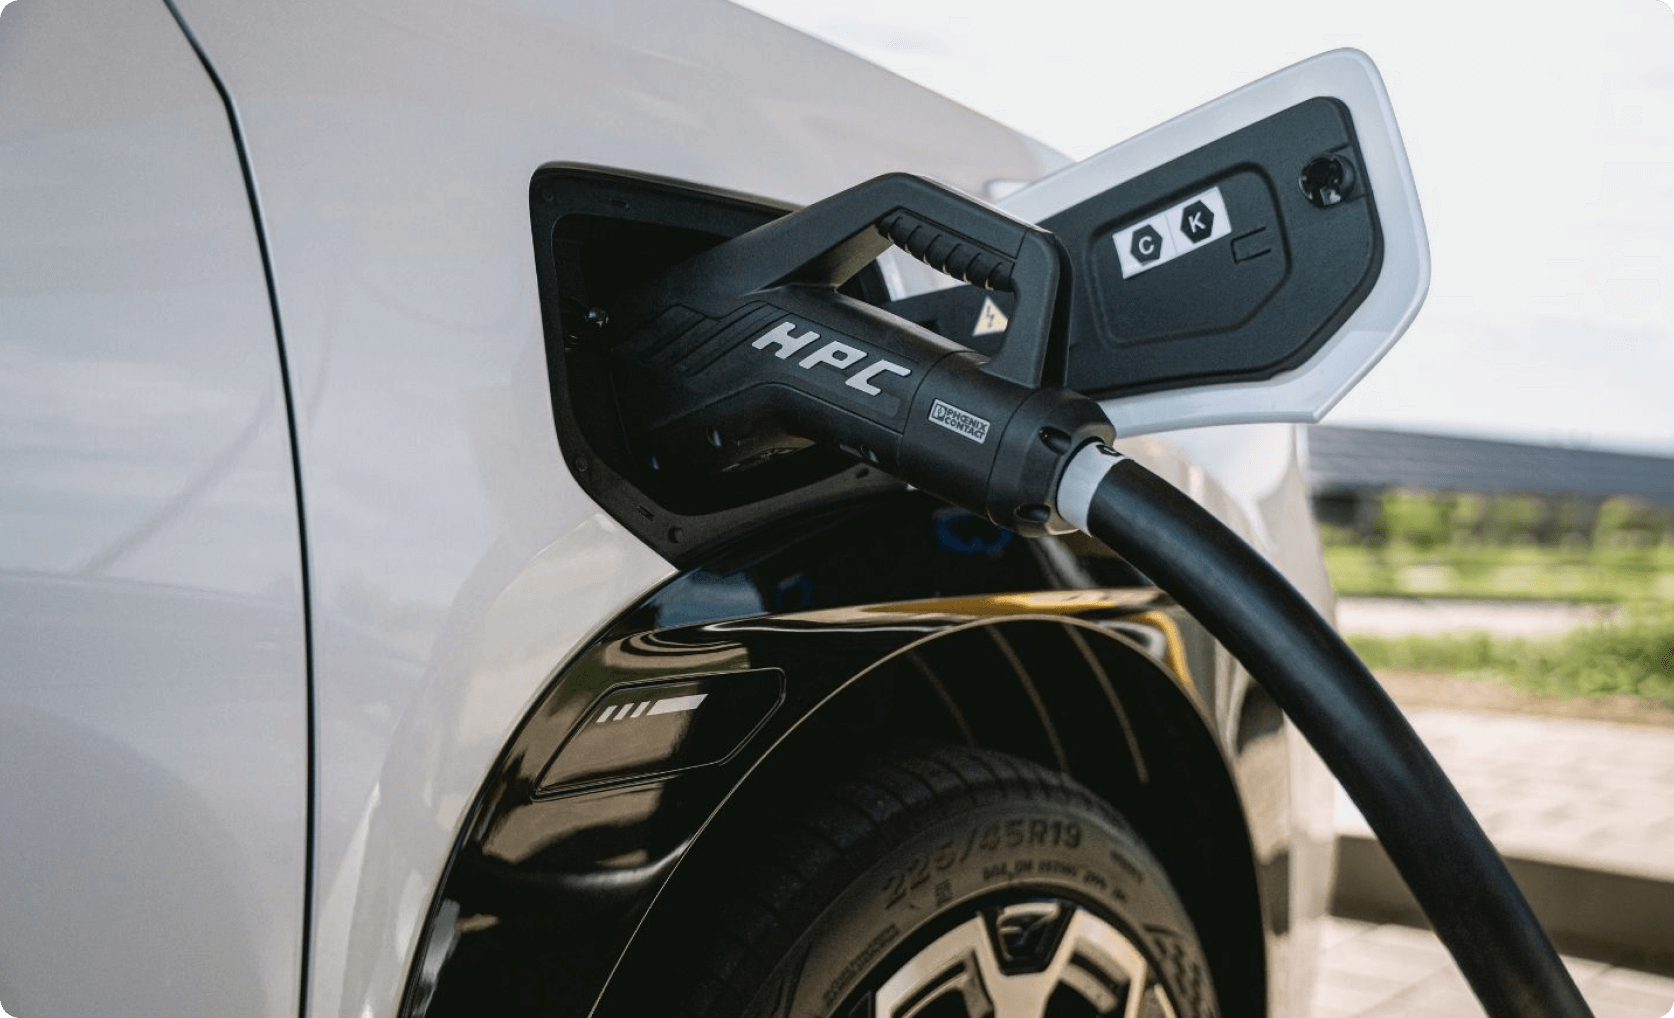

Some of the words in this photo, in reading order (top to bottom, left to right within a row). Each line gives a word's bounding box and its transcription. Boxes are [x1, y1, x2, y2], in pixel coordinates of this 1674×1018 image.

[1138, 235, 1155, 256] C
[1188, 212, 1206, 233] K
[751, 321, 912, 397] HPC
[944, 416, 986, 440] CONTACT
